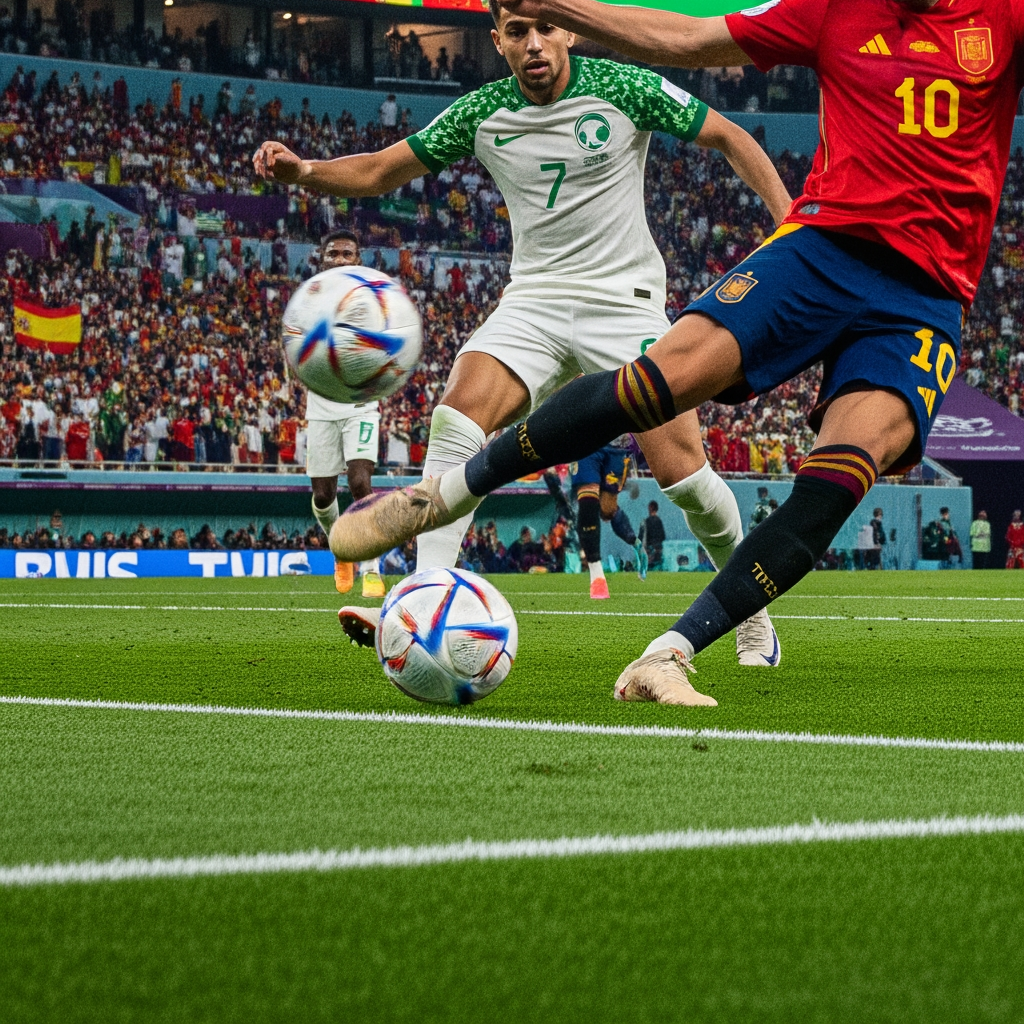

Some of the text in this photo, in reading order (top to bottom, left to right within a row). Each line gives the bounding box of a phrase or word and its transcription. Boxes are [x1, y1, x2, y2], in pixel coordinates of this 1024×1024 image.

[894, 77, 960, 138] 10
[540, 162, 567, 209] 7
[909, 328, 957, 395] 10
